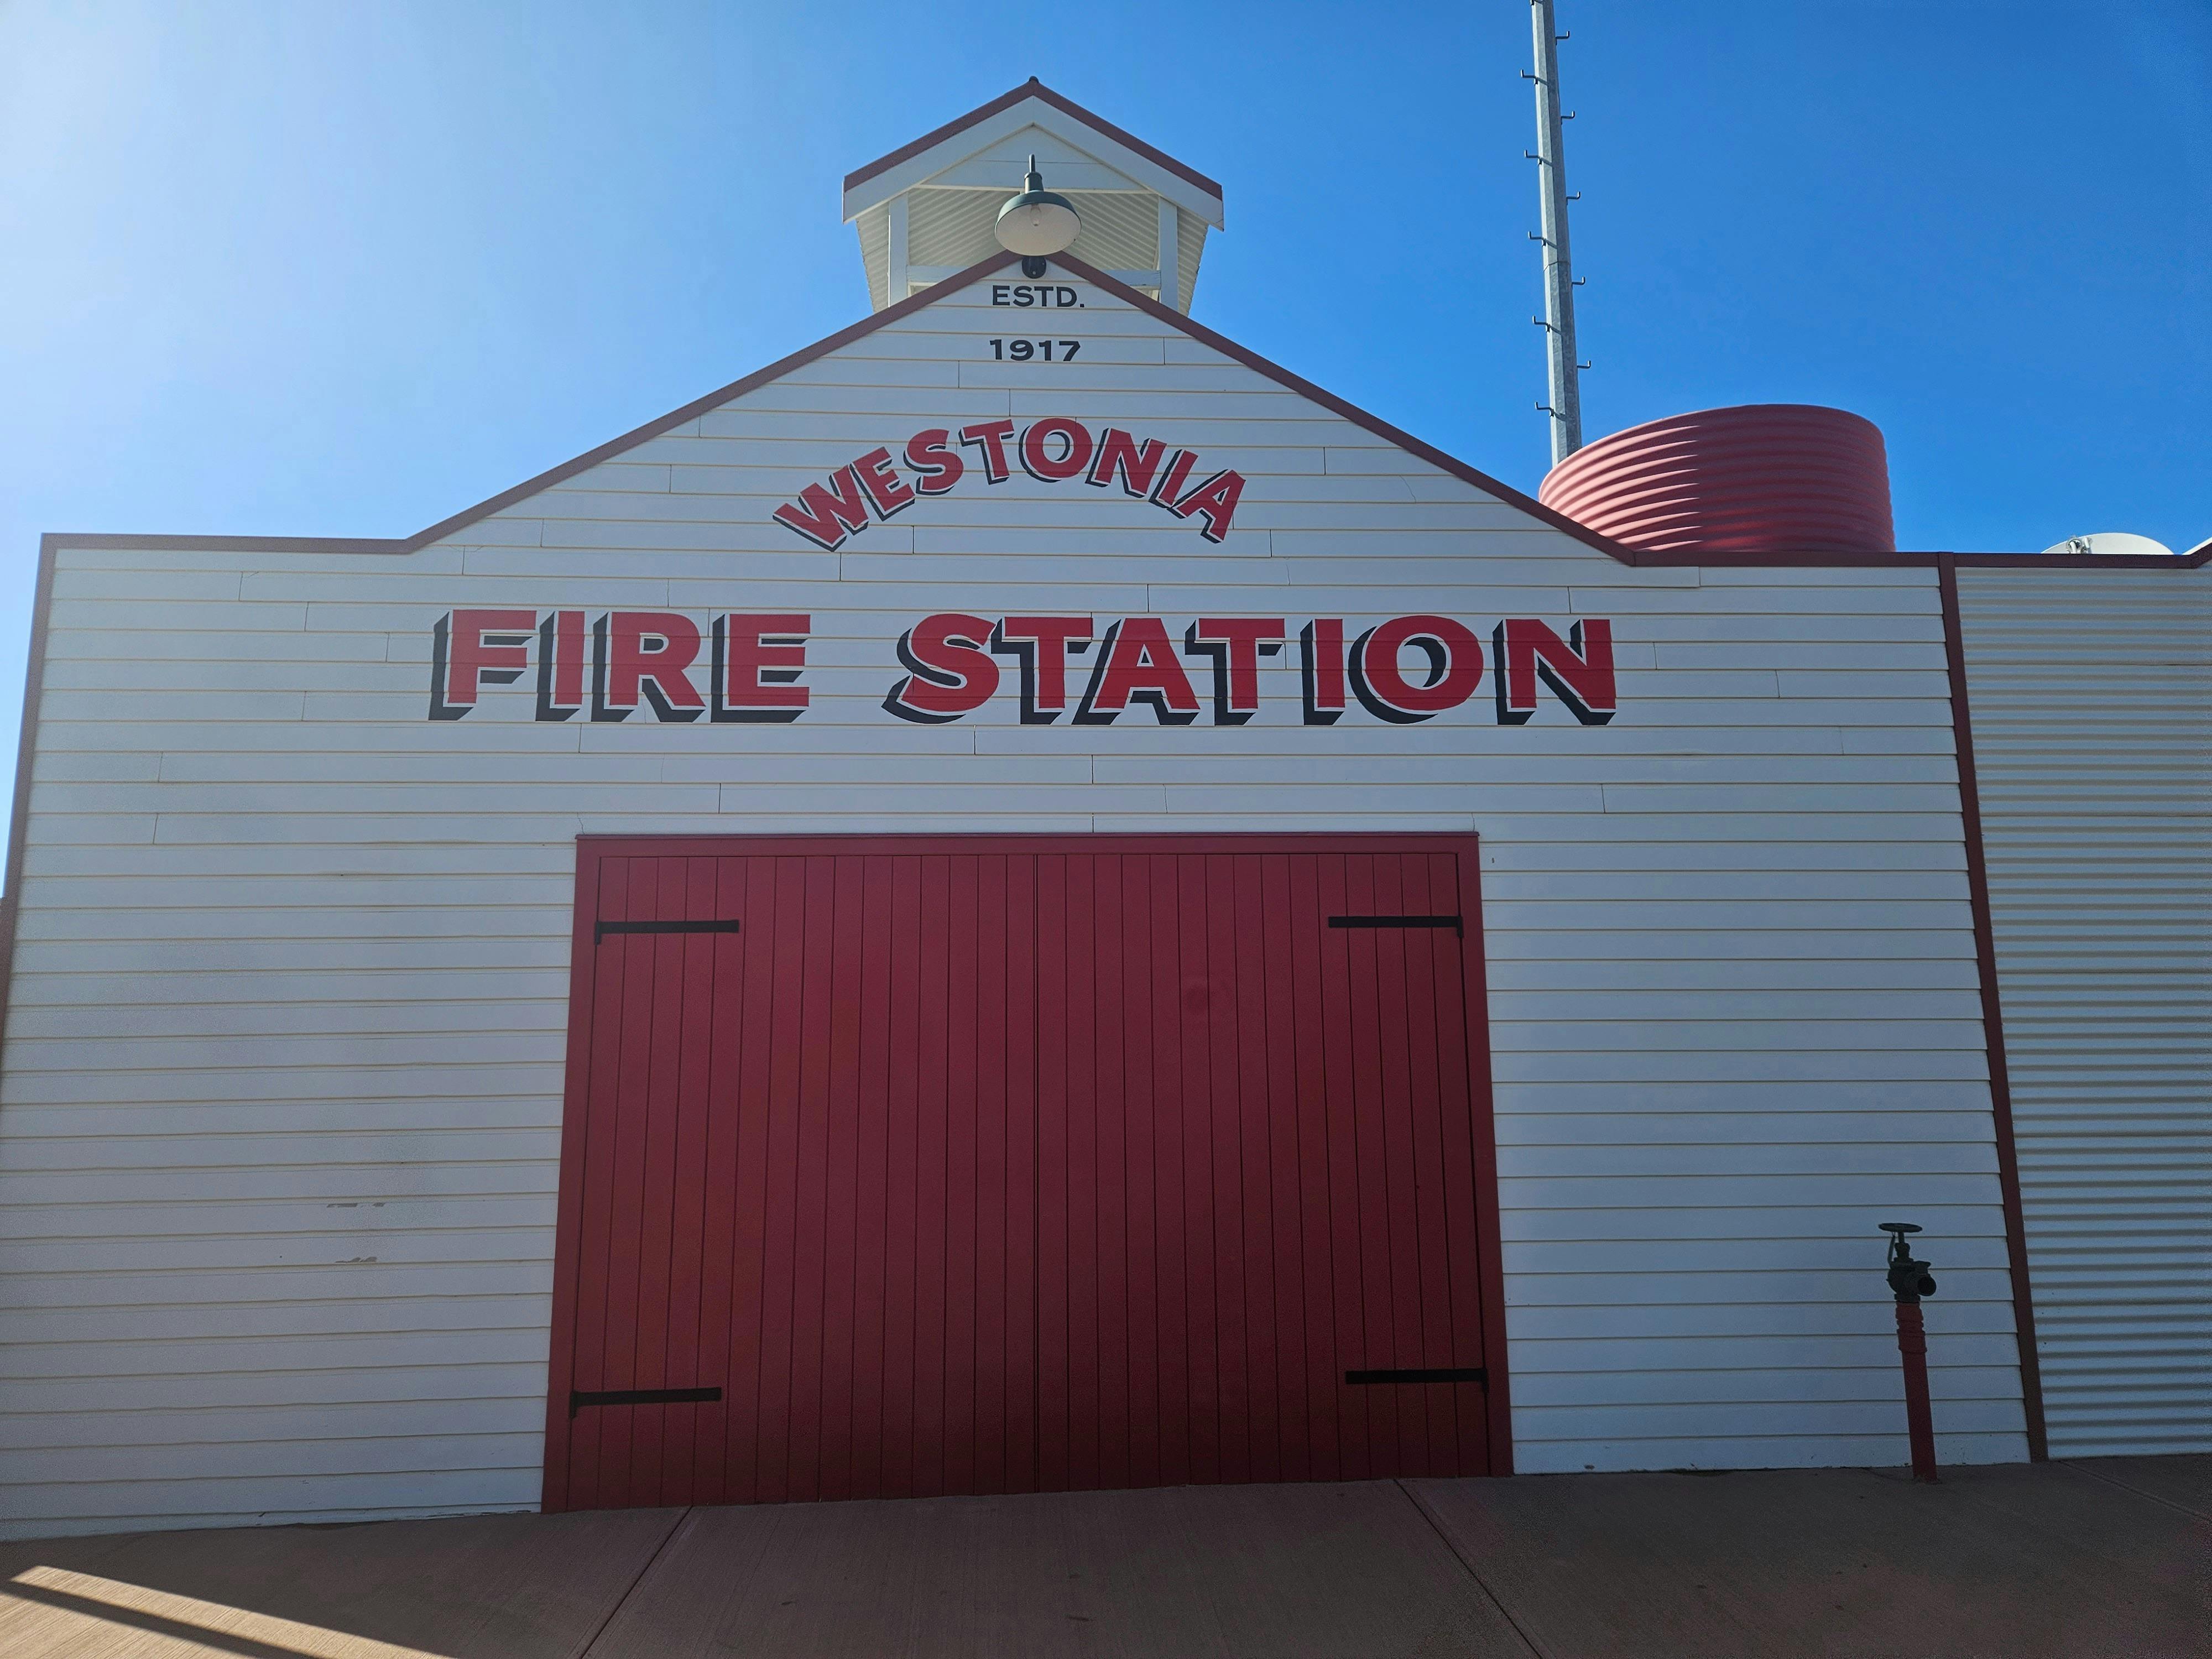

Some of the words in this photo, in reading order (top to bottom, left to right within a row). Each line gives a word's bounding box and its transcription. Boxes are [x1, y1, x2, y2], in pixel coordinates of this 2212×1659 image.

[992, 285, 1085, 308] ESTD.
[989, 338, 1081, 362] 1917
[772, 417, 1246, 552] WESTONIA
[428, 609, 811, 723] FIRE
[881, 613, 1616, 726] STATION
